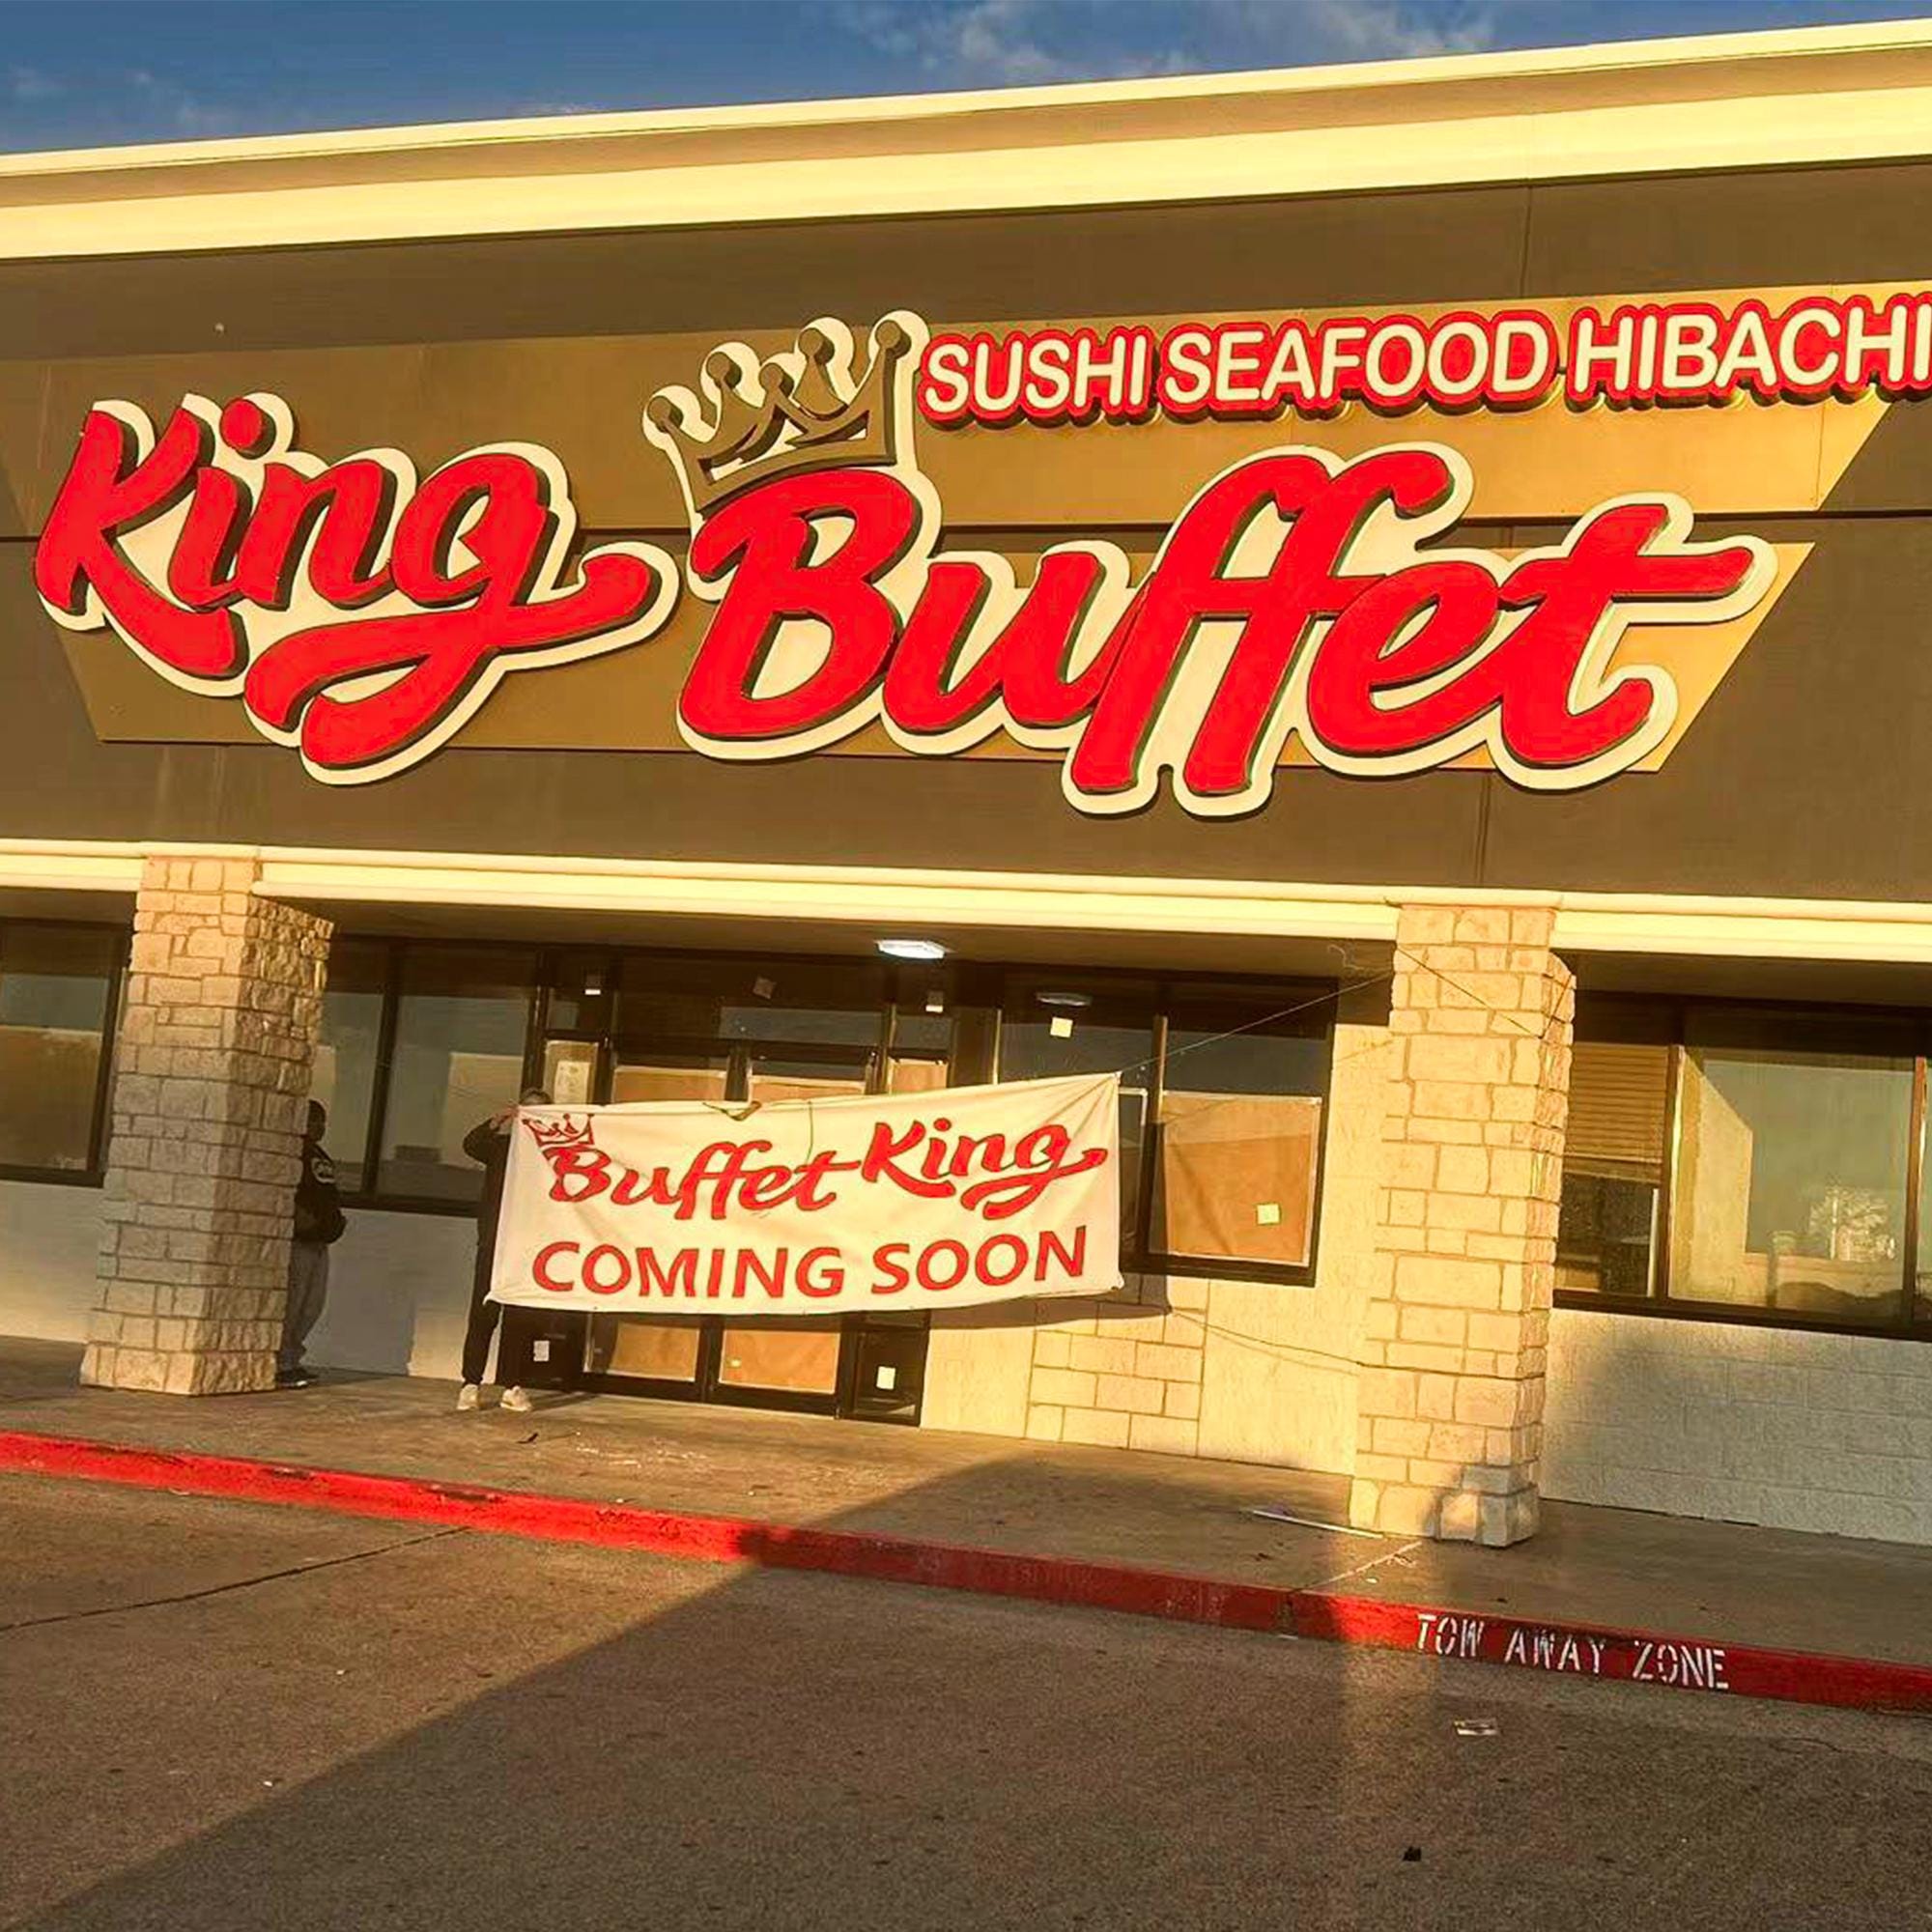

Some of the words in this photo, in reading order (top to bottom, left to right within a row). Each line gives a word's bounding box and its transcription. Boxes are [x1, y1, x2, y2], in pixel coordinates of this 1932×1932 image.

[924, 334, 1148, 416] SUSHI
[1164, 323, 1549, 408] SEAFOOD
[1574, 301, 1932, 393] HIBACHI
[34, 396, 665, 769] King
[679, 449, 1754, 792] Buffet
[543, 1140, 862, 1220] Buffet
[863, 1118, 1108, 1220] King
[533, 1240, 844, 1298] COMING
[871, 1225, 1087, 1294] SOON
[1417, 1614, 1484, 1658] TOW
[1504, 1629, 1605, 1674] AWAY
[1633, 1640, 1729, 1689] ZONE
